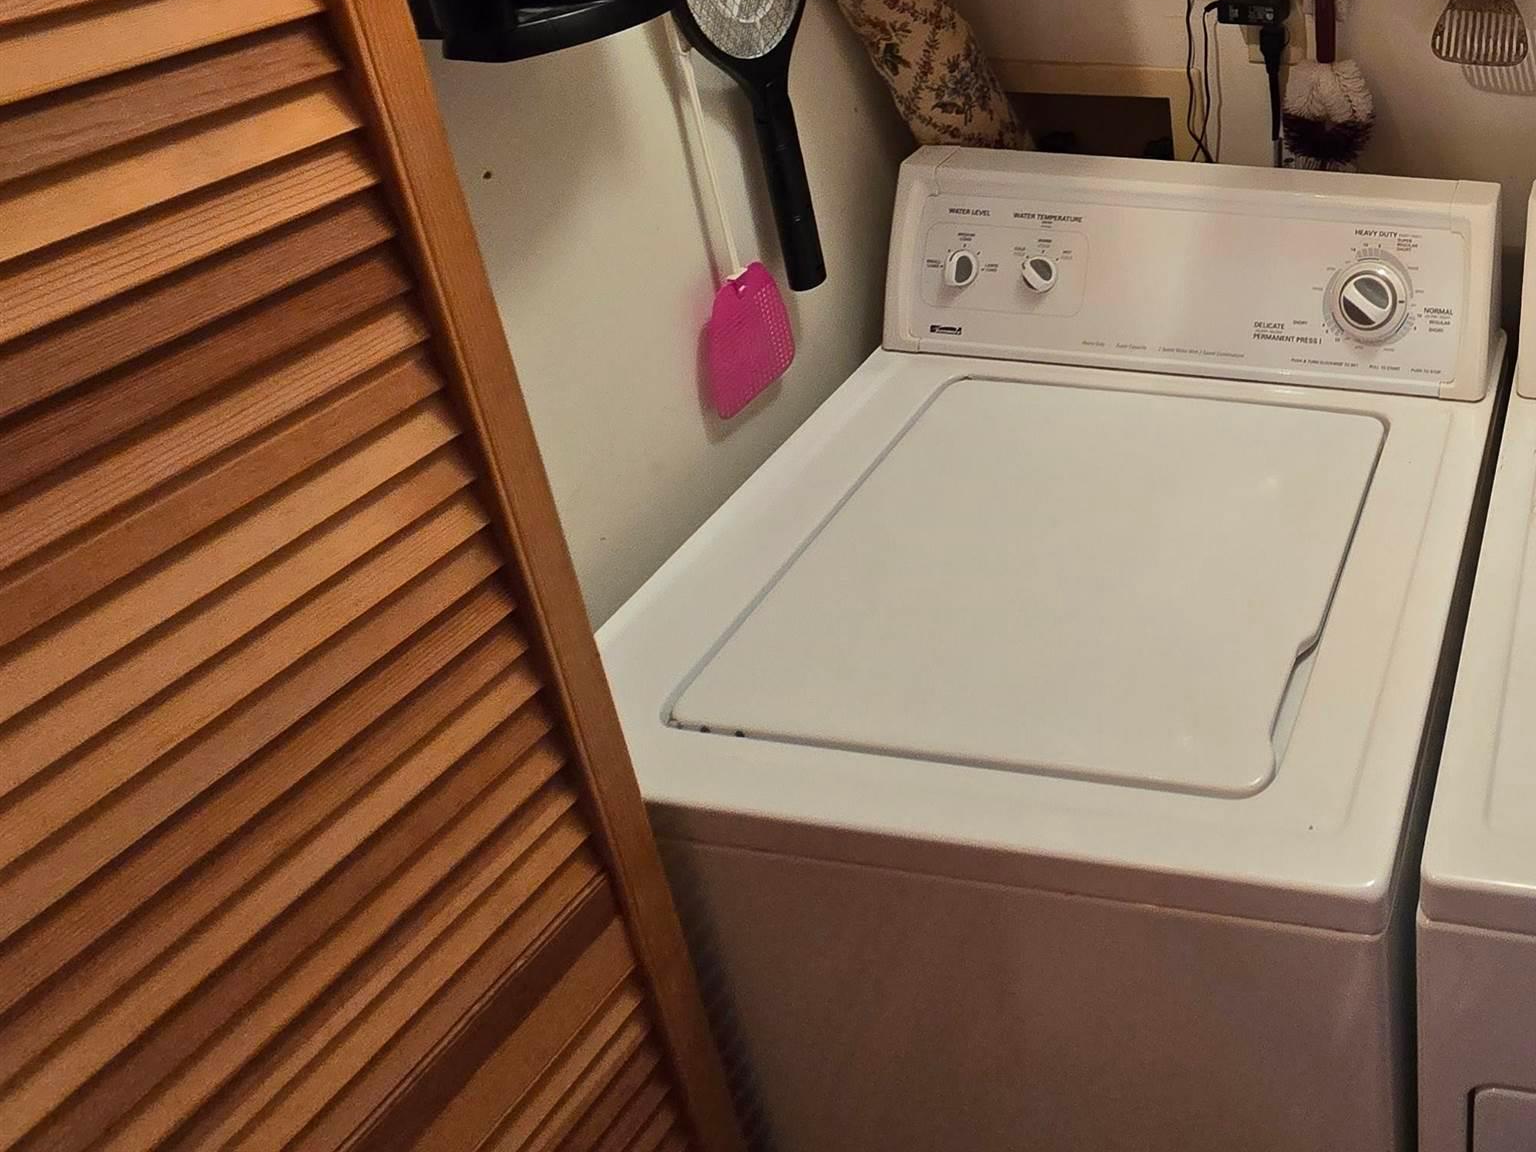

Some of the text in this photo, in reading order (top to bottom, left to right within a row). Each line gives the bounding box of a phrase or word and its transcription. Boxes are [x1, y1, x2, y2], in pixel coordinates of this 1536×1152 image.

[1036, 214, 1084, 223] TEMPERATURE
[1378, 230, 1398, 238] DUTY
[1424, 307, 1454, 316] NORMAL
[1253, 321, 1286, 330] DELICATE
[1252, 333, 1318, 344] PERMANENT PRESS
